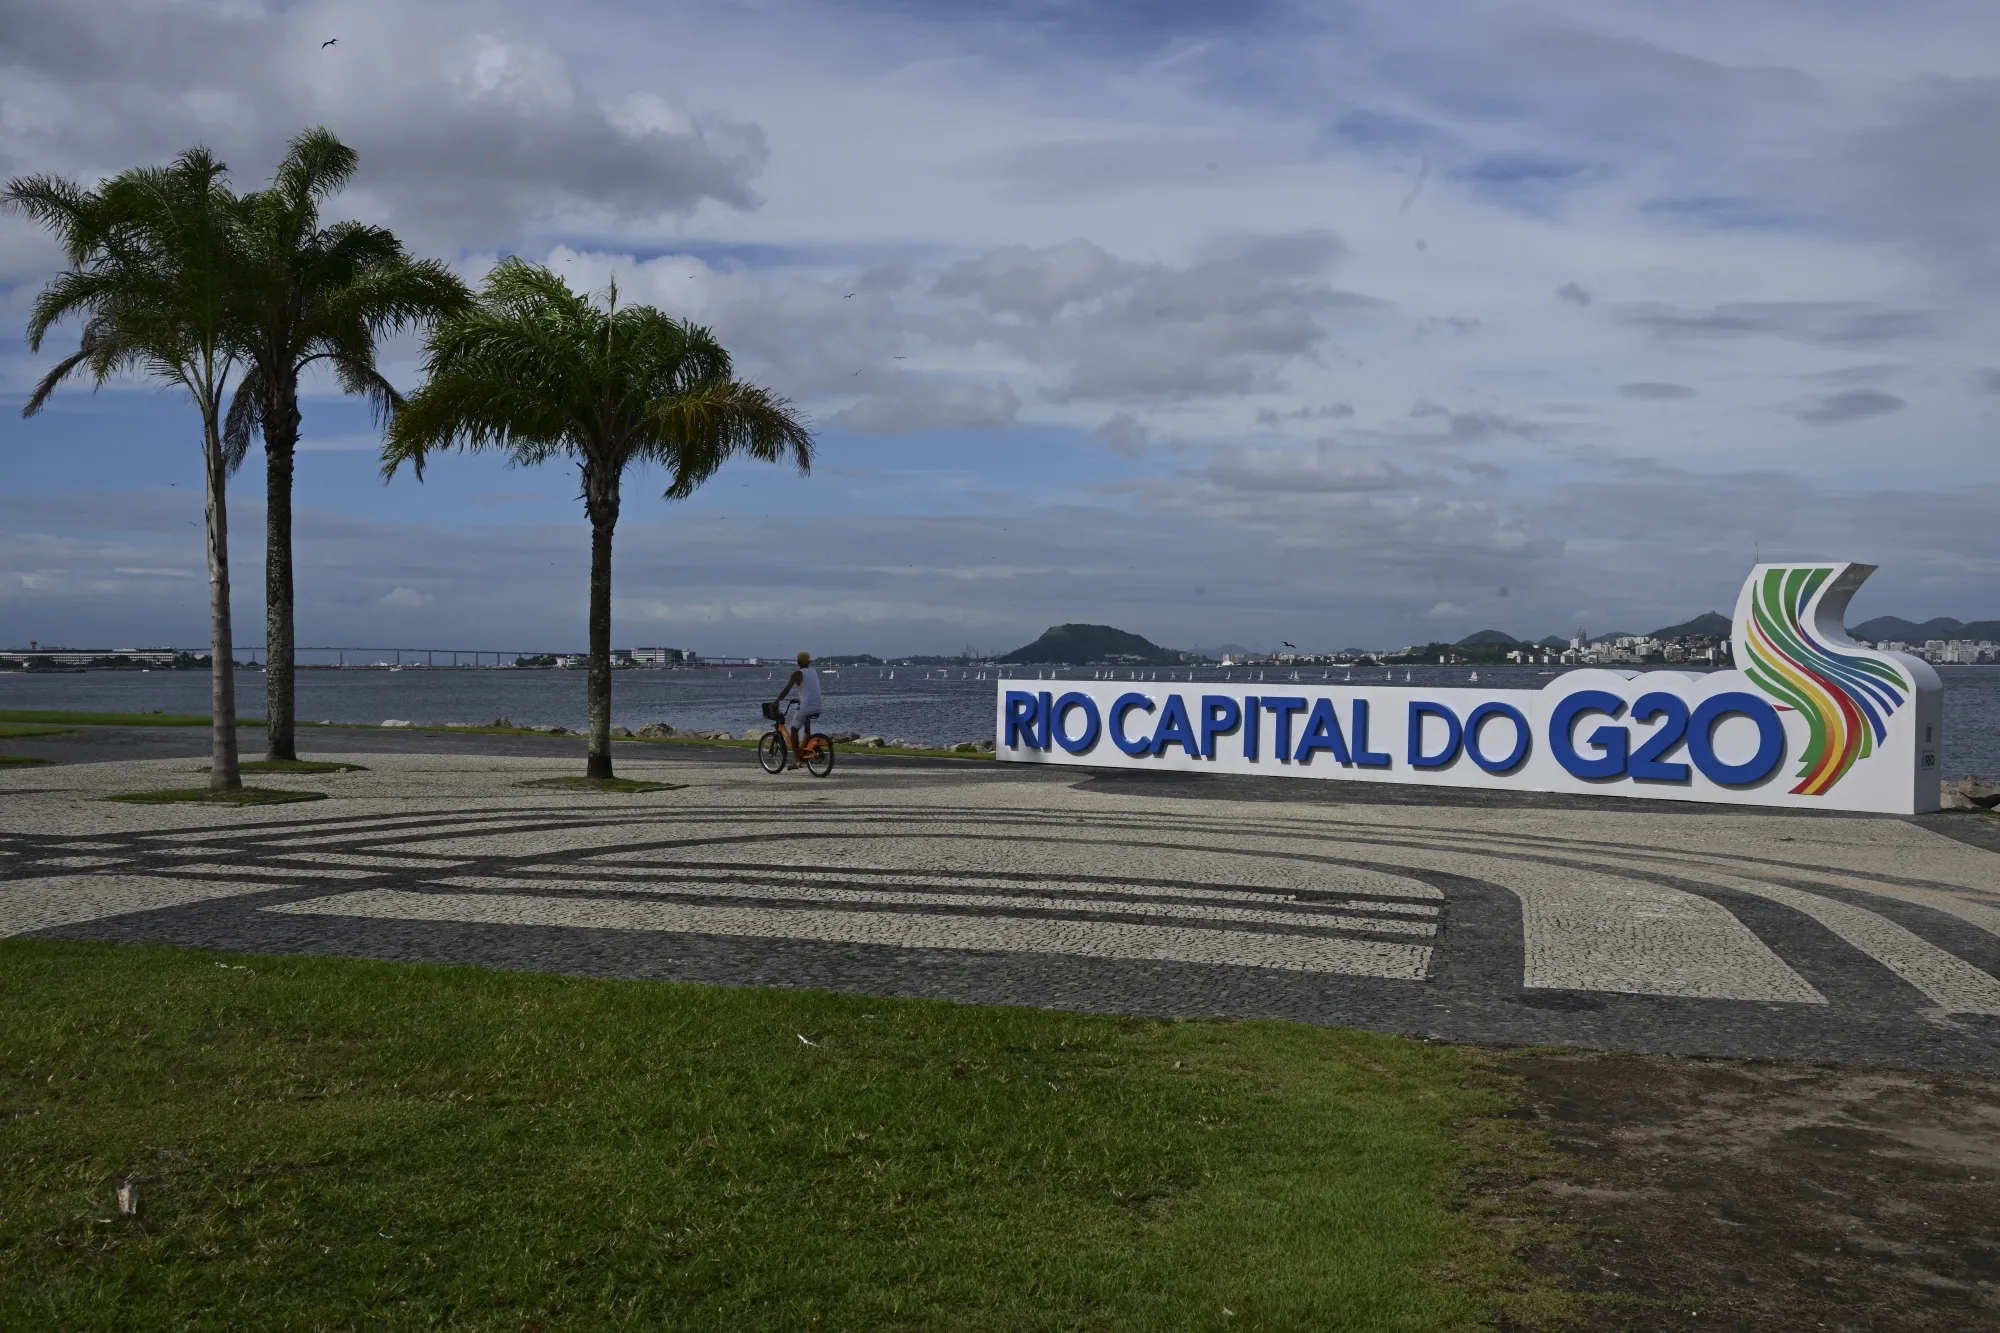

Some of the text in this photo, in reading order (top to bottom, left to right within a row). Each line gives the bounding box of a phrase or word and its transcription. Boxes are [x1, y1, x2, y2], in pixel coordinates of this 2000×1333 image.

[1004, 690, 1784, 785] RIO CAPITAL DO G20
